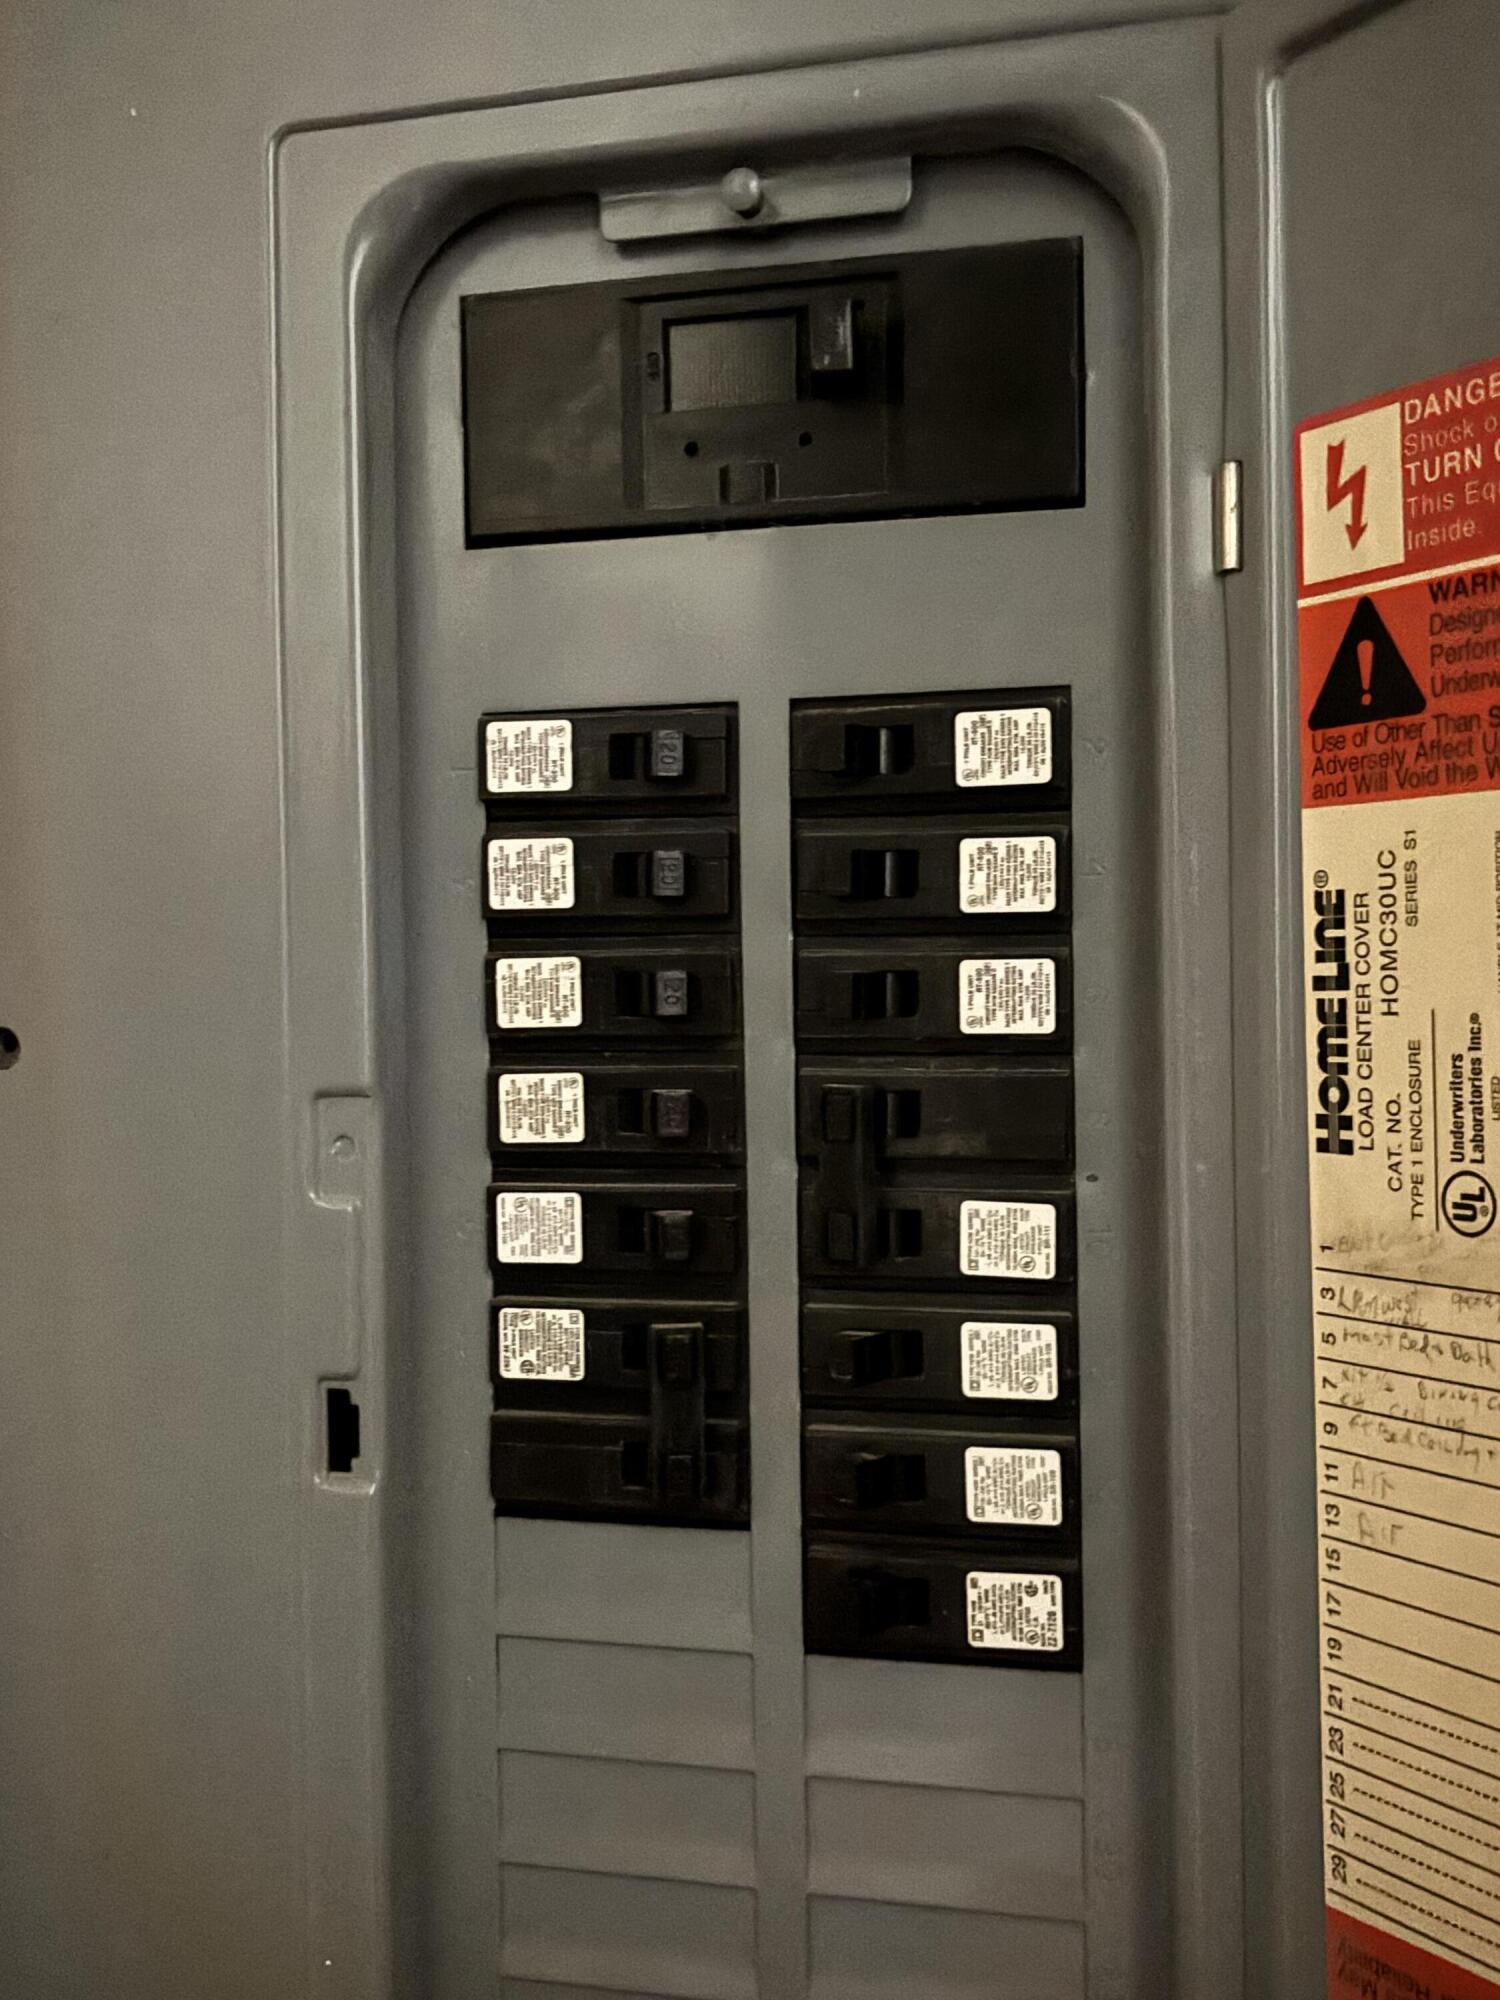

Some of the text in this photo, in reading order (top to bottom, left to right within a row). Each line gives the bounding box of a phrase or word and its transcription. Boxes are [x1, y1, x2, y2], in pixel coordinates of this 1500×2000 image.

[1403, 417, 1475, 457] Shock
[1403, 443, 1483, 487] TURN
[1406, 492, 1456, 519] This
[1311, 731, 1346, 754] Use
[1351, 723, 1370, 748] of
[1374, 721, 1427, 745] Other
[1431, 713, 1481, 736] Than
[660, 743, 677, 766] 20
[1311, 745, 1406, 777] Adversely
[1414, 736, 1475, 764] Affect
[1312, 775, 1348, 800] and
[1353, 770, 1389, 795] Will
[1395, 764, 1439, 790] Void
[1445, 761, 1480, 785] the
[1403, 829, 1419, 928] SERIES S1
[664, 979, 682, 1006] 20
[1353, 891, 1375, 1151] LOAD CENTER COVER
[1377, 849, 1403, 1192] CAT. NO. HOMC30UC
[1407, 1038, 1423, 1153] ENCLOSURE
[1449, 1053, 1465, 1163] Underwriters
[1467, 1056, 1485, 1165] Laboratories
[1410, 1172, 1424, 1221] TYPE
[1451, 1186, 1486, 1222] UL
[1318, 1244, 1335, 1253] 1
[1319, 1286, 1336, 1301] 3
[1321, 1331, 1337, 1346] 5
[1322, 1375, 1339, 1390] 7
[1323, 1421, 1339, 1436] 9
[1324, 1462, 1339, 1483] 11
[1324, 1503, 1341, 1527] 13
[1325, 1547, 1341, 1571] 15
[1326, 1591, 1342, 1617] 17
[1327, 1636, 1343, 1661] 19
[1327, 1683, 1343, 1712] 21
[1328, 1726, 1345, 1756] 23
[1329, 1770, 1346, 1800] 25
[1330, 1808, 1347, 1838] 27
[1331, 1856, 1348, 1884] 29
